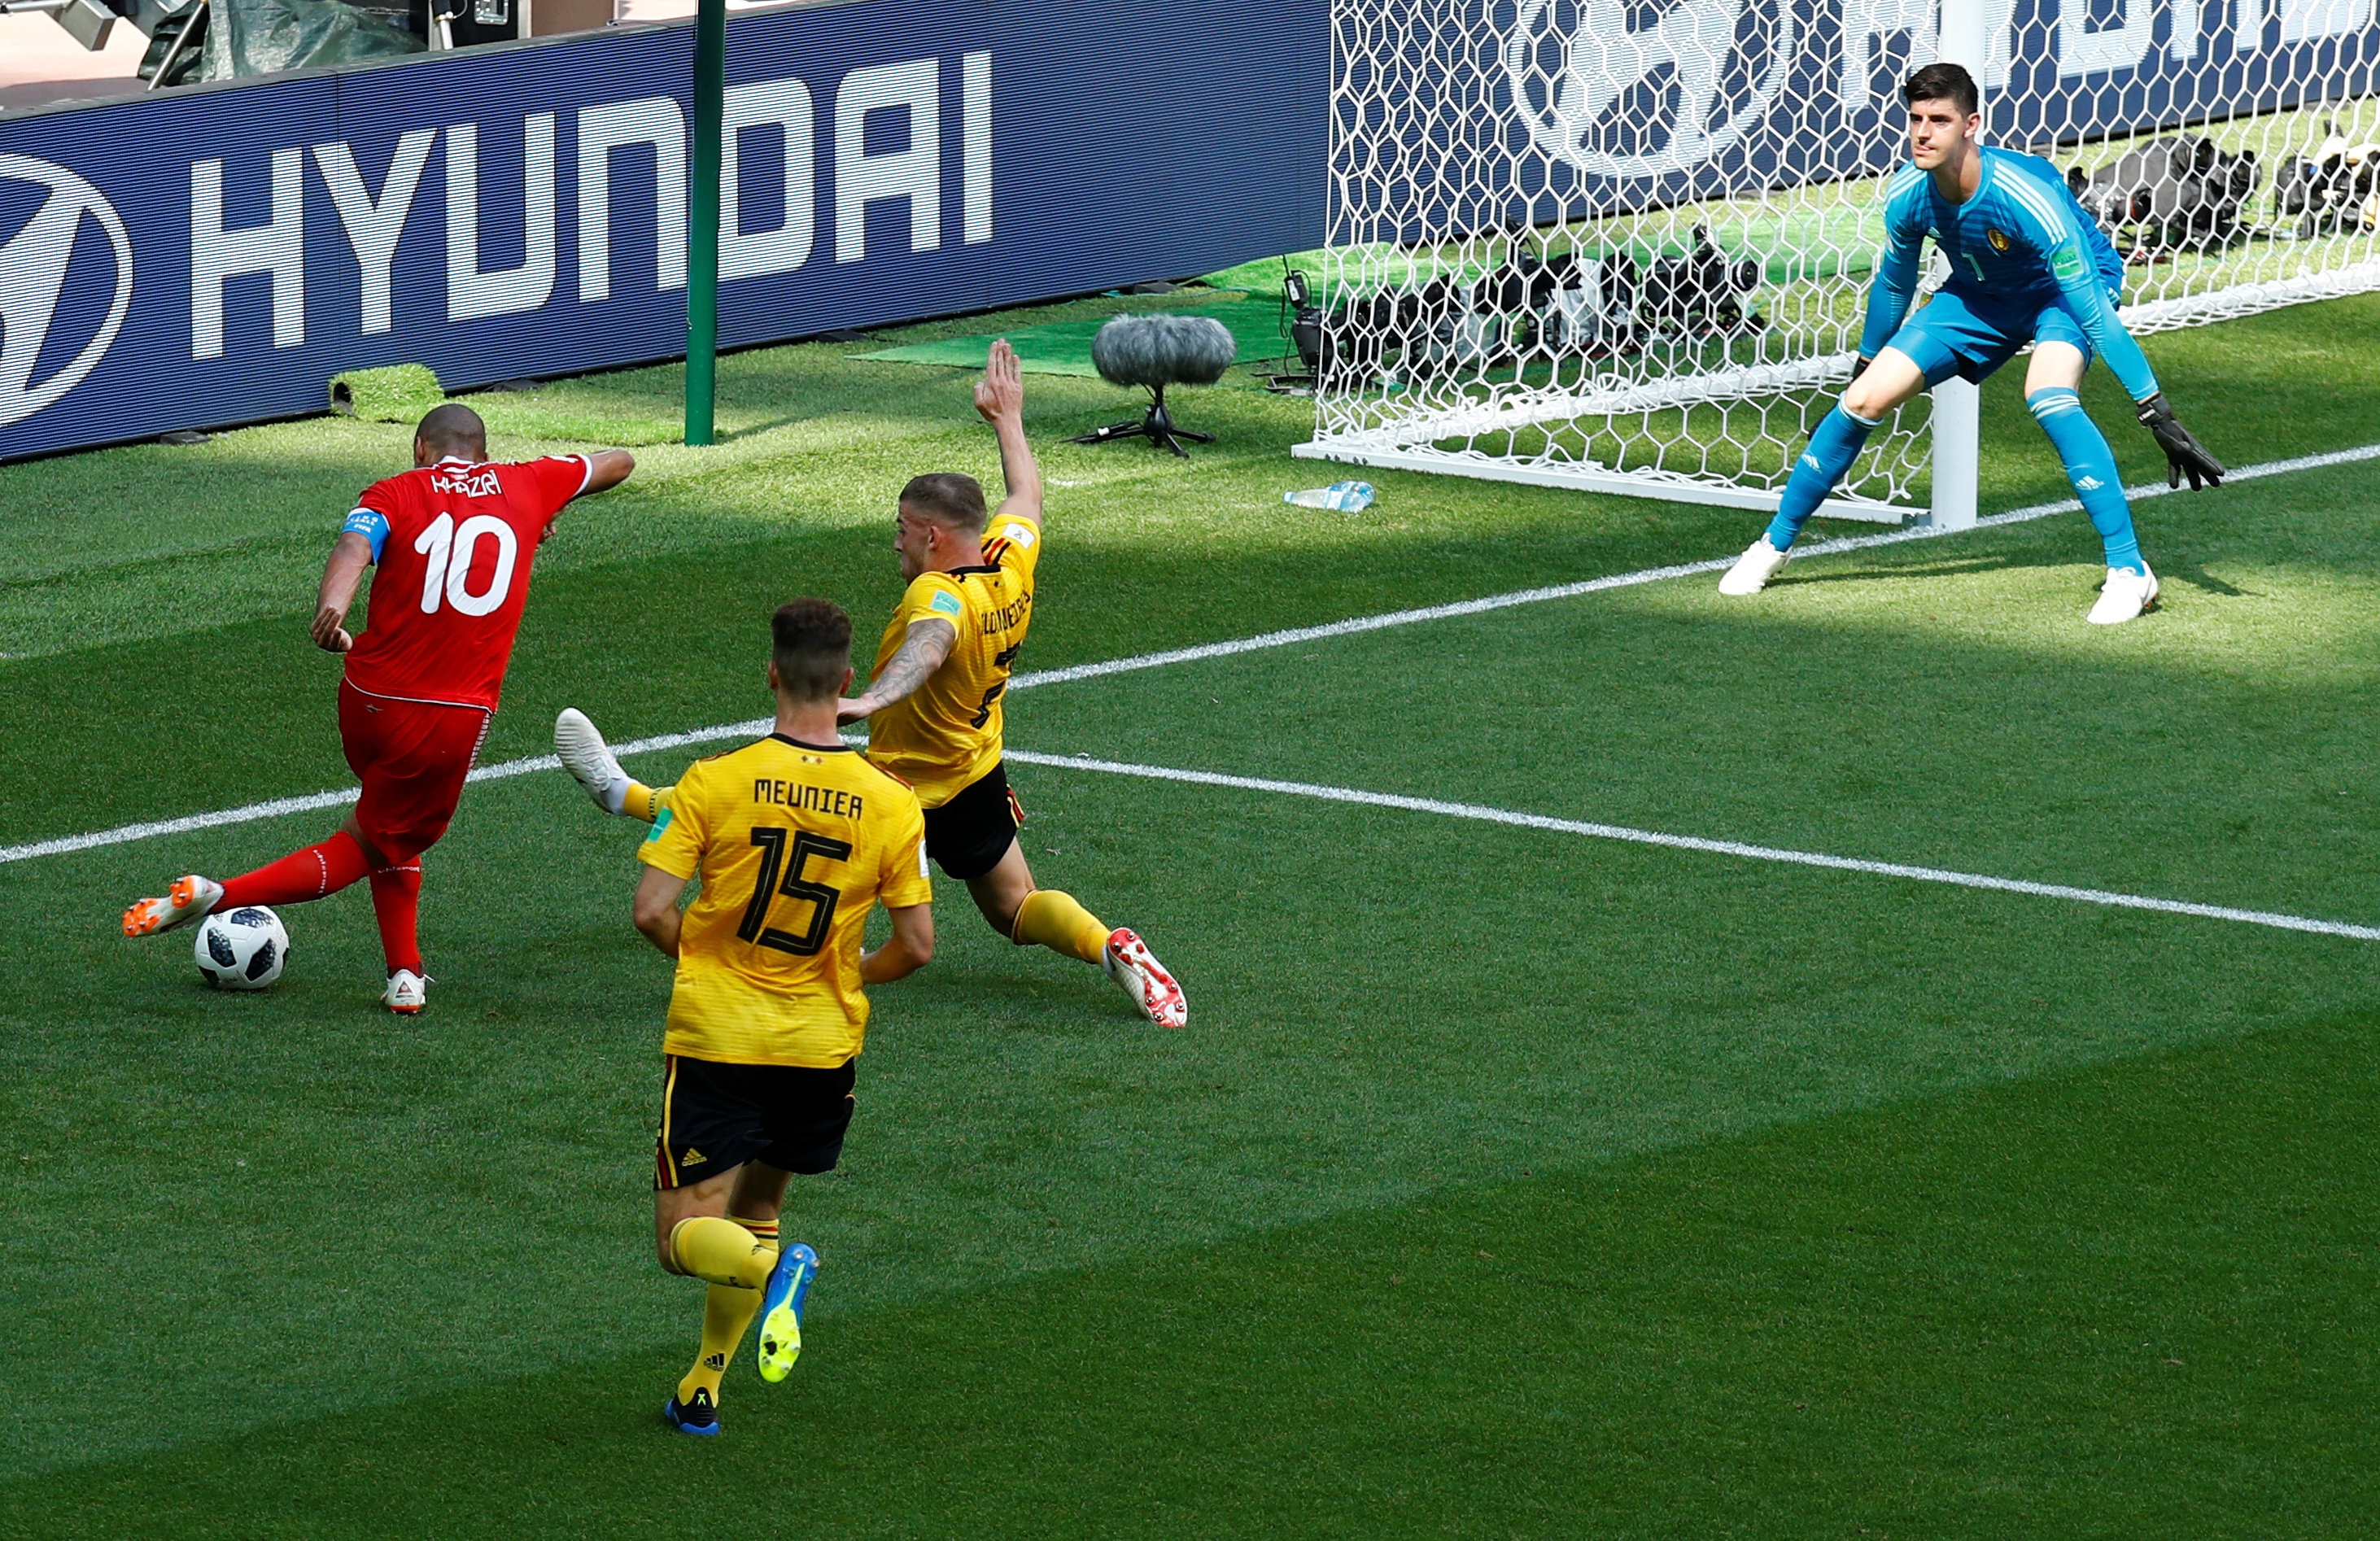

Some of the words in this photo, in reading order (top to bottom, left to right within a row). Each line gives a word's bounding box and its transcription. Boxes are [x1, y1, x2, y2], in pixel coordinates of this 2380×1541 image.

[190, 50, 993, 360] HYUNDAI
[413, 511, 517, 617] 10
[754, 779, 863, 820] MEUNIER
[736, 827, 853, 957] 15
